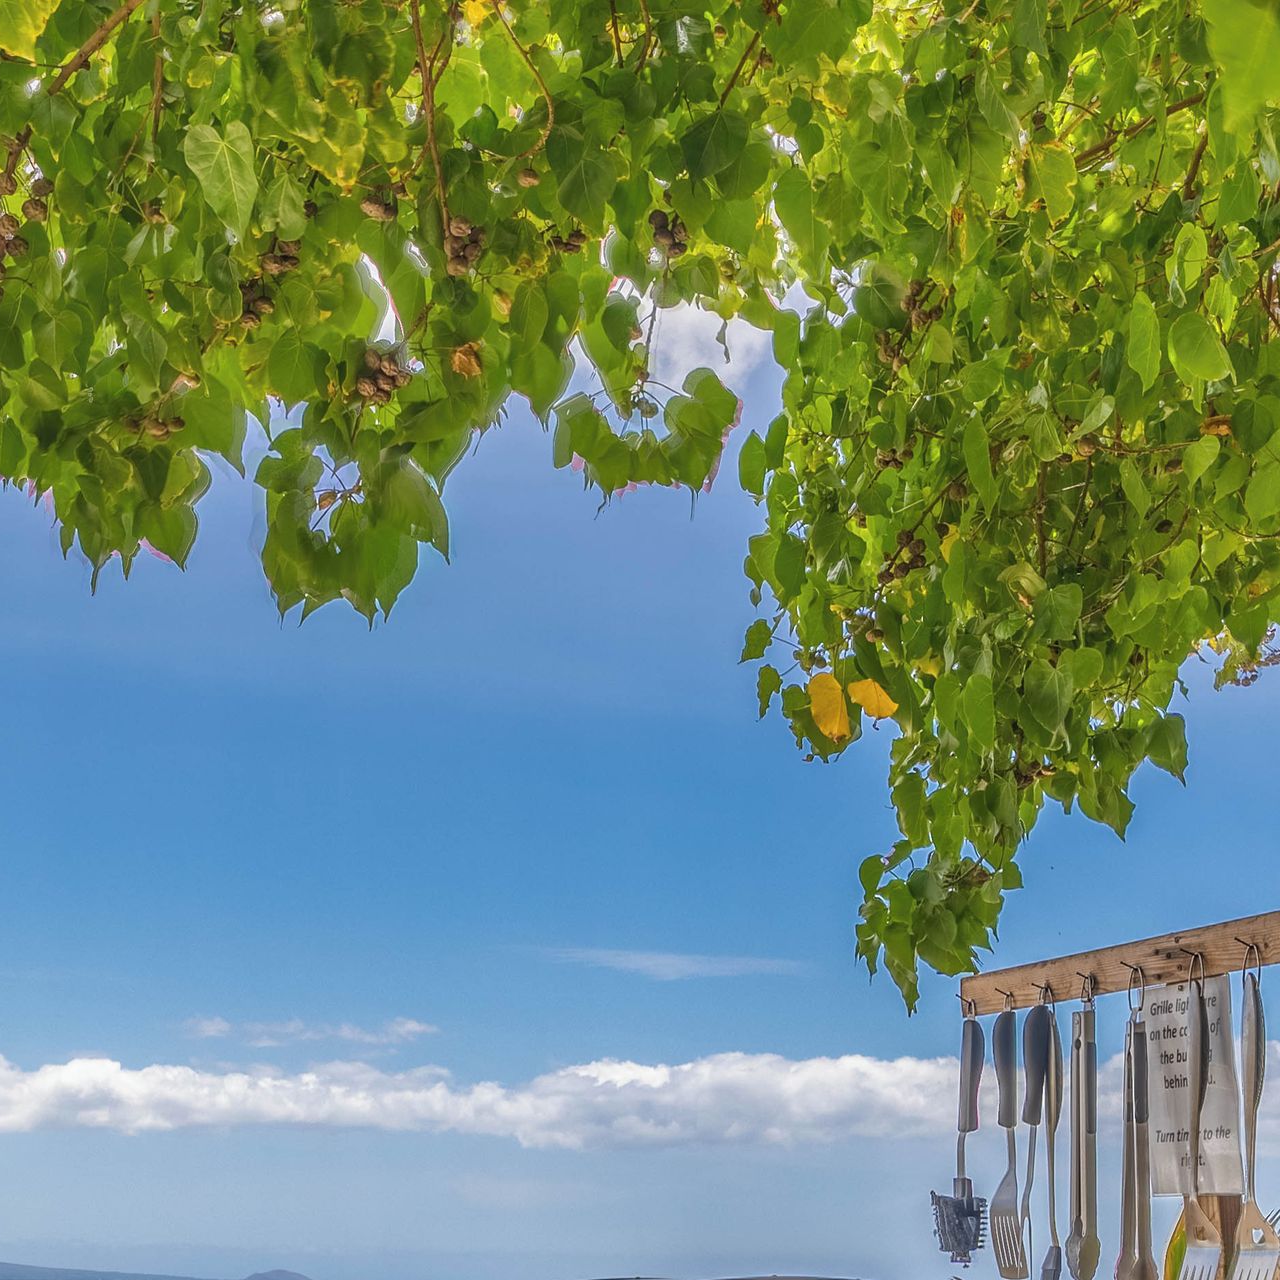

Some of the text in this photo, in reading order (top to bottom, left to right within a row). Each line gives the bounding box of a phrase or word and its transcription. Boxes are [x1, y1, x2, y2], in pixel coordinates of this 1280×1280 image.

[1150, 1000, 1174, 1016] Grille
[1150, 1029, 1161, 1041] on
[1163, 1025, 1177, 1039] the
[1210, 1018, 1221, 1036] of
[1160, 1050, 1174, 1065] the
[1163, 1073, 1188, 1090] behin
[1156, 1129, 1175, 1143] Turn
[1203, 1127, 1213, 1140] to
[1216, 1124, 1231, 1139] the
